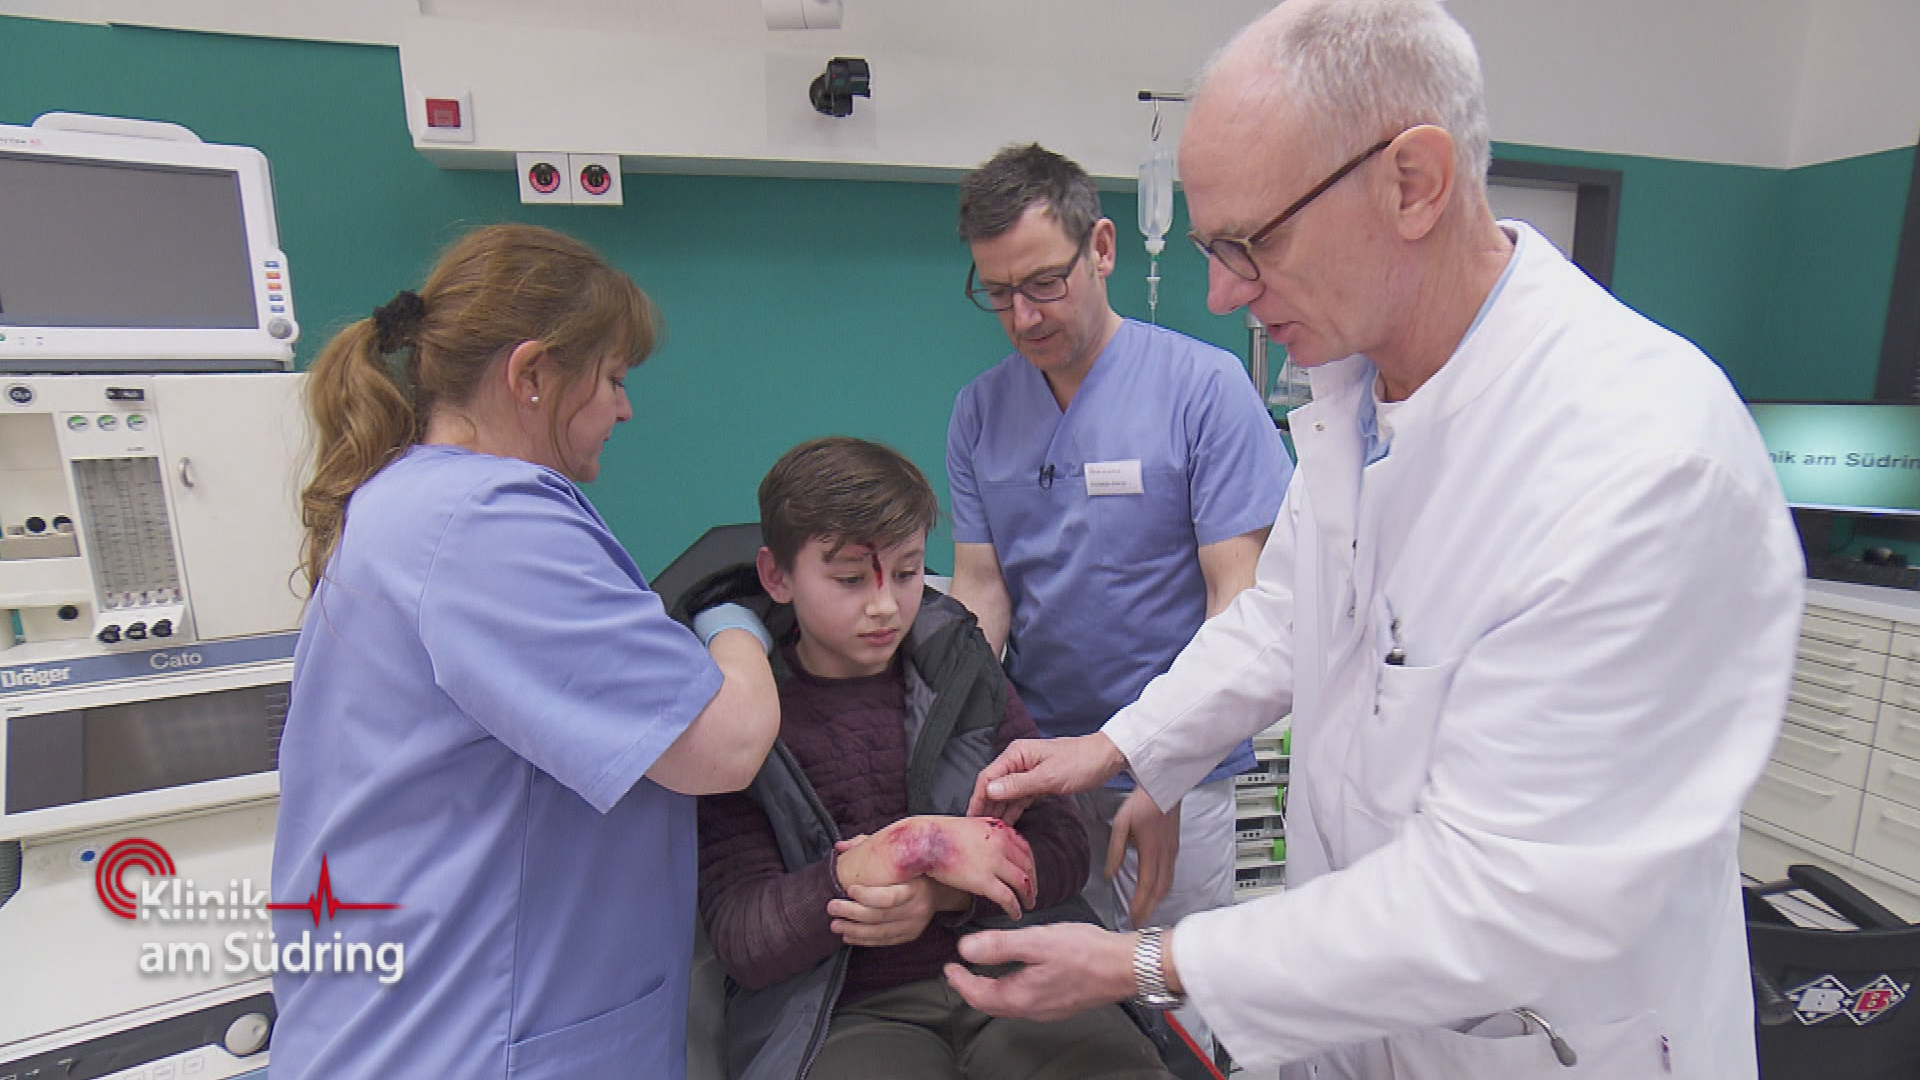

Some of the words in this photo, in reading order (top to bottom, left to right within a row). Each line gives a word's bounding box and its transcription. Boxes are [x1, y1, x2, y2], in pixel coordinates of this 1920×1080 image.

[1768, 450, 1796, 464] nik
[1803, 453, 1837, 466] am
[1846, 452, 1920, 469] Südrin
[150, 653, 202, 669] Cato
[1, 667, 71, 688] Dräger
